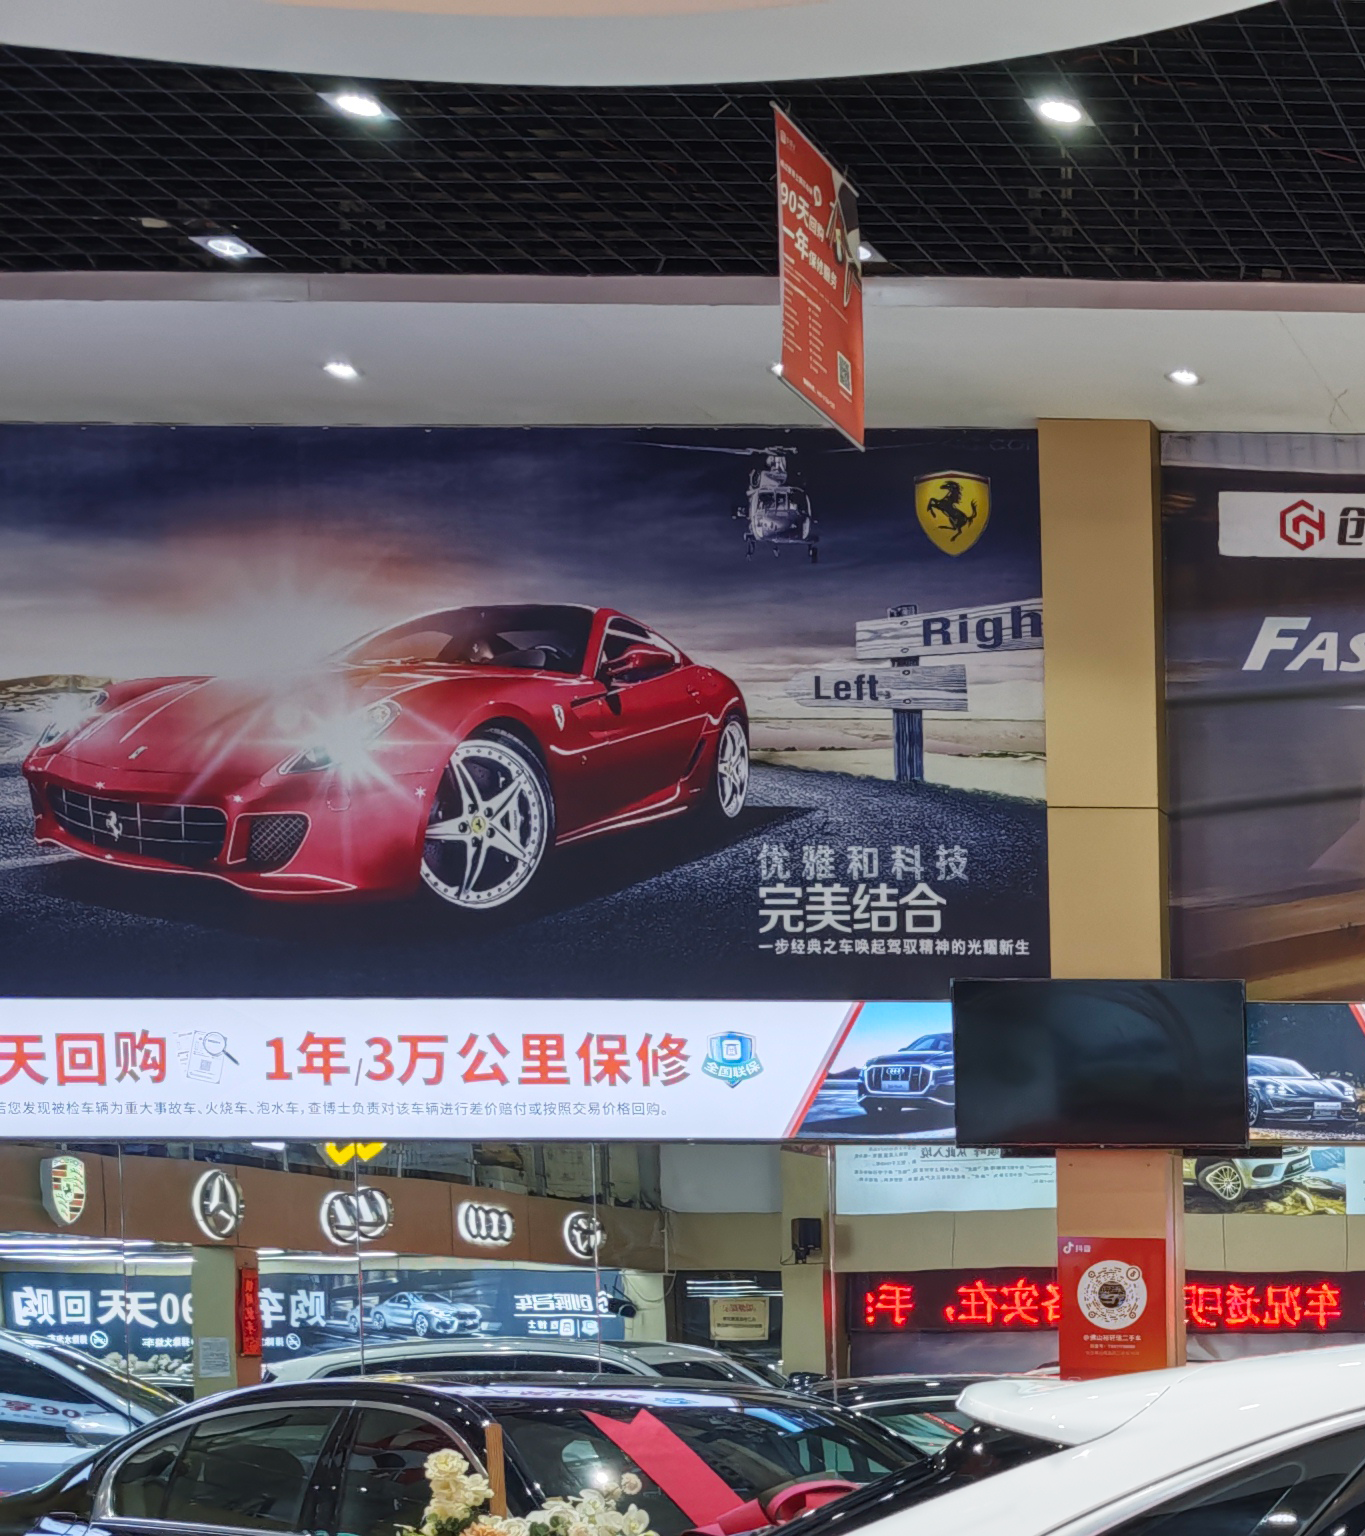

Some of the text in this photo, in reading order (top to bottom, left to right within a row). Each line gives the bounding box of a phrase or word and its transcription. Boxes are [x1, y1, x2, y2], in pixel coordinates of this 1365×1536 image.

[814, 673, 880, 701] Left
[758, 843, 969, 882] 优雅和科技
[758, 882, 947, 934] 完美结合
